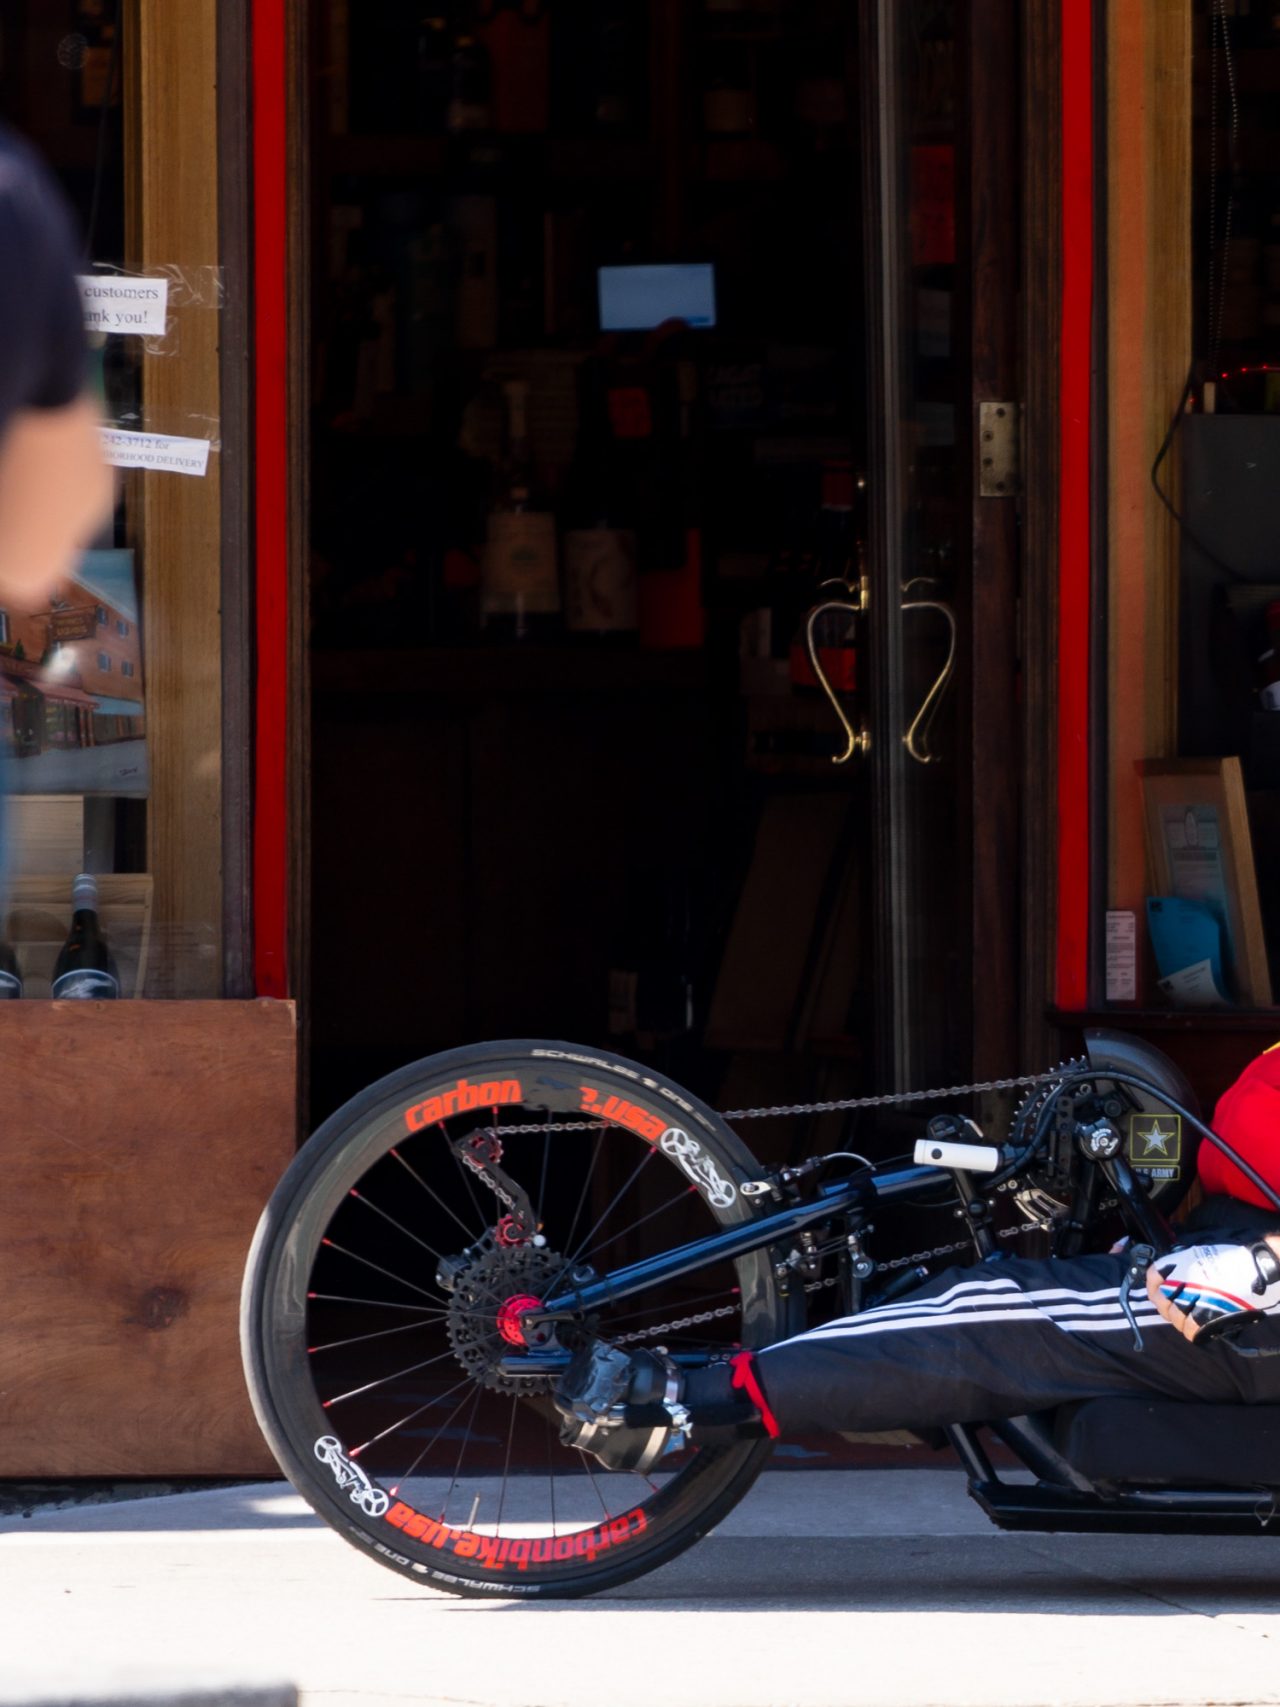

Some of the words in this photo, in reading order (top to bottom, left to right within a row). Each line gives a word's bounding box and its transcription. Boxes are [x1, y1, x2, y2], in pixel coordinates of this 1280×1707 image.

[84, 285, 160, 299] customers
[115, 309, 148, 327] you!
[155, 437, 169, 449] for
[156, 455, 205, 469] DELIVERY
[531, 1048, 640, 1079] SCHWALBE
[659, 1086, 694, 1112] ONE
[1151, 1168, 1175, 1178] ARMY
[385, 1502, 648, 1571] carbonbike.usa
[431, 1569, 541, 1594] SCHWALBE
